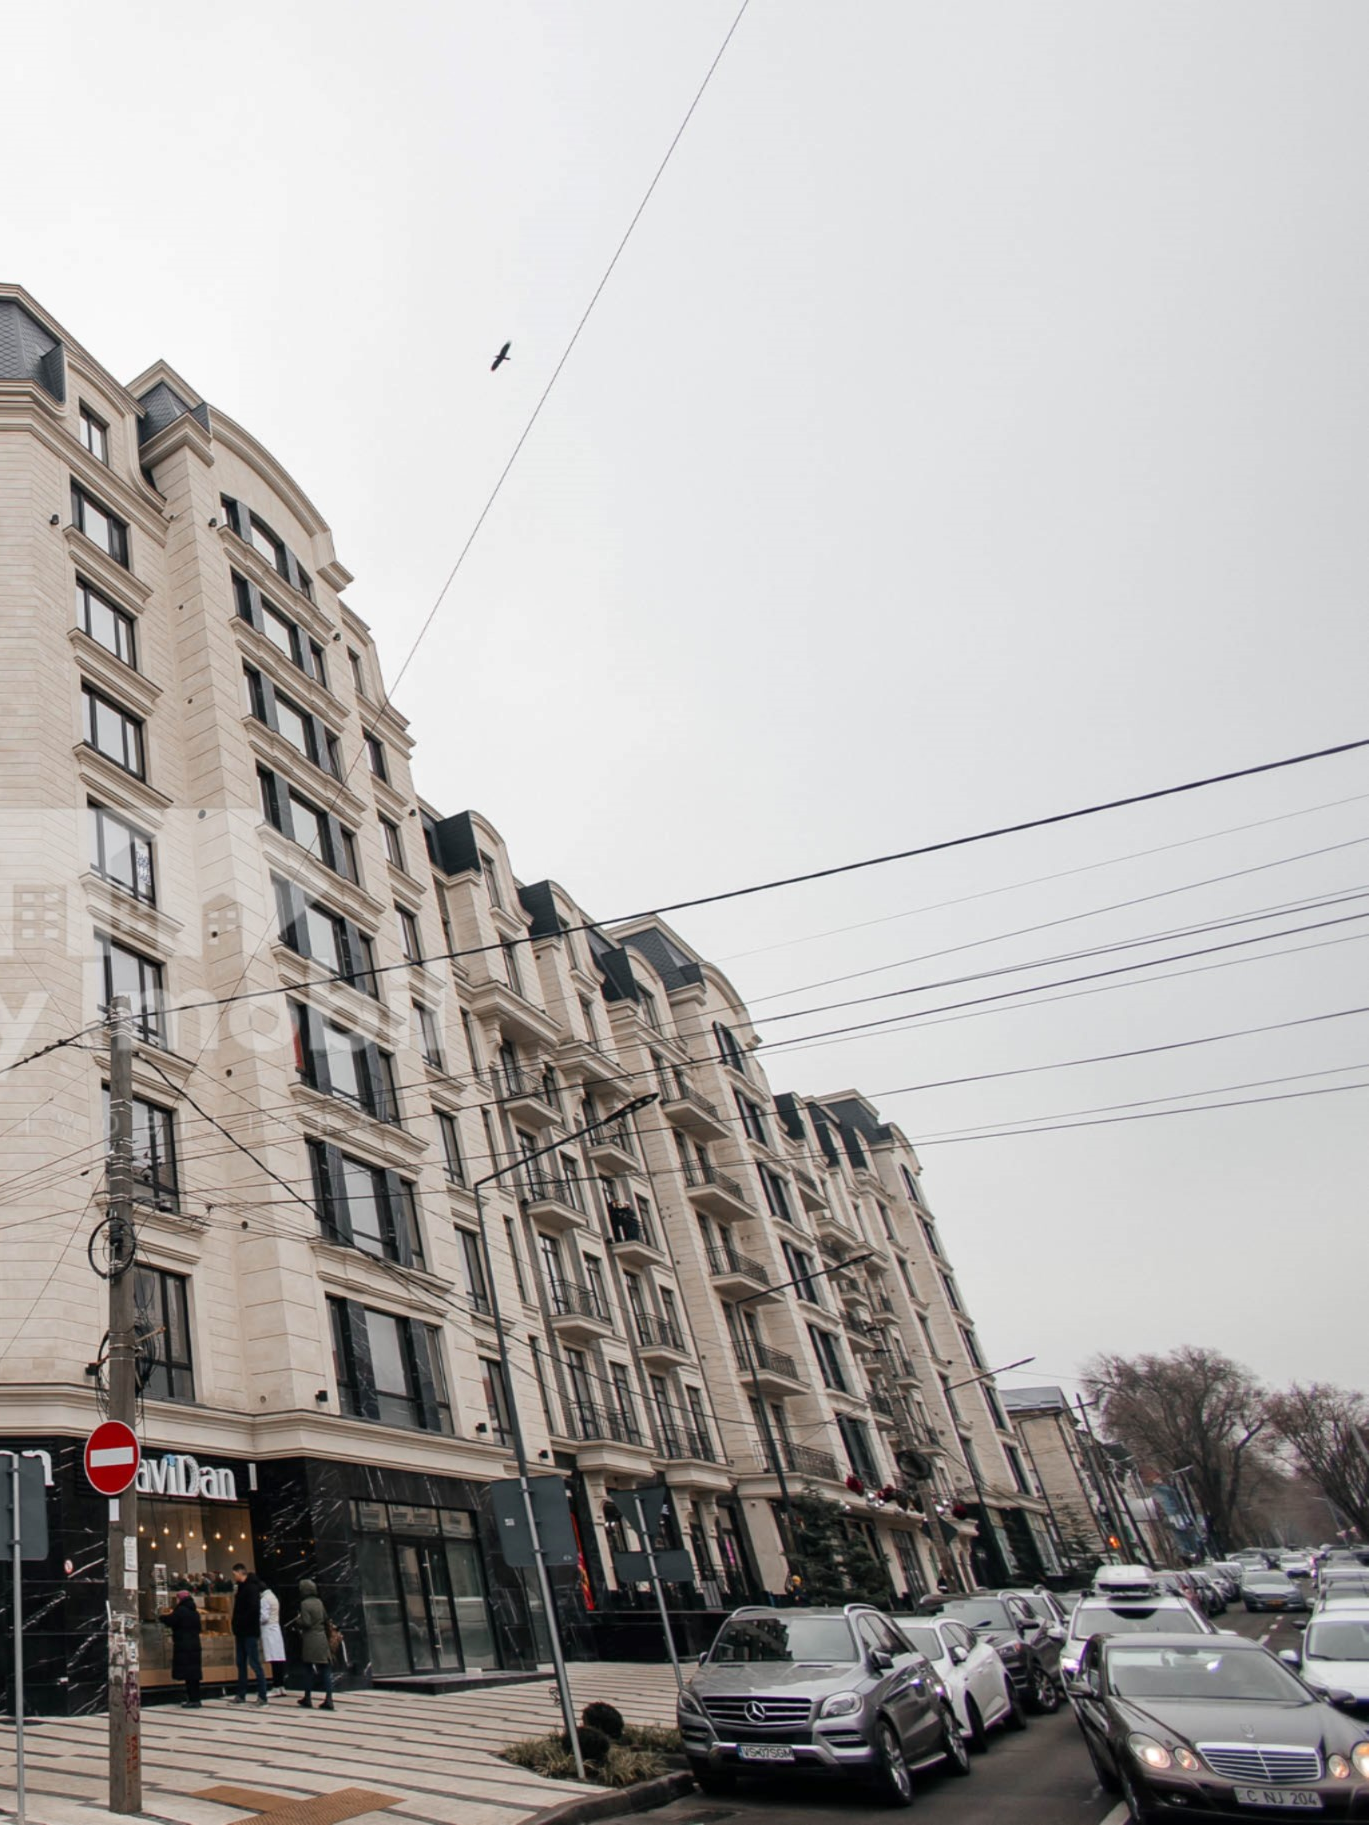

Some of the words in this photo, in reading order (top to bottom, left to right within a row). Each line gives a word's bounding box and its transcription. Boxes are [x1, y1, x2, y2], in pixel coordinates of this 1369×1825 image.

[135, 1454, 238, 1501] aviDan
[1247, 1790, 1258, 1802] C
[1290, 1792, 1317, 1805] 204
